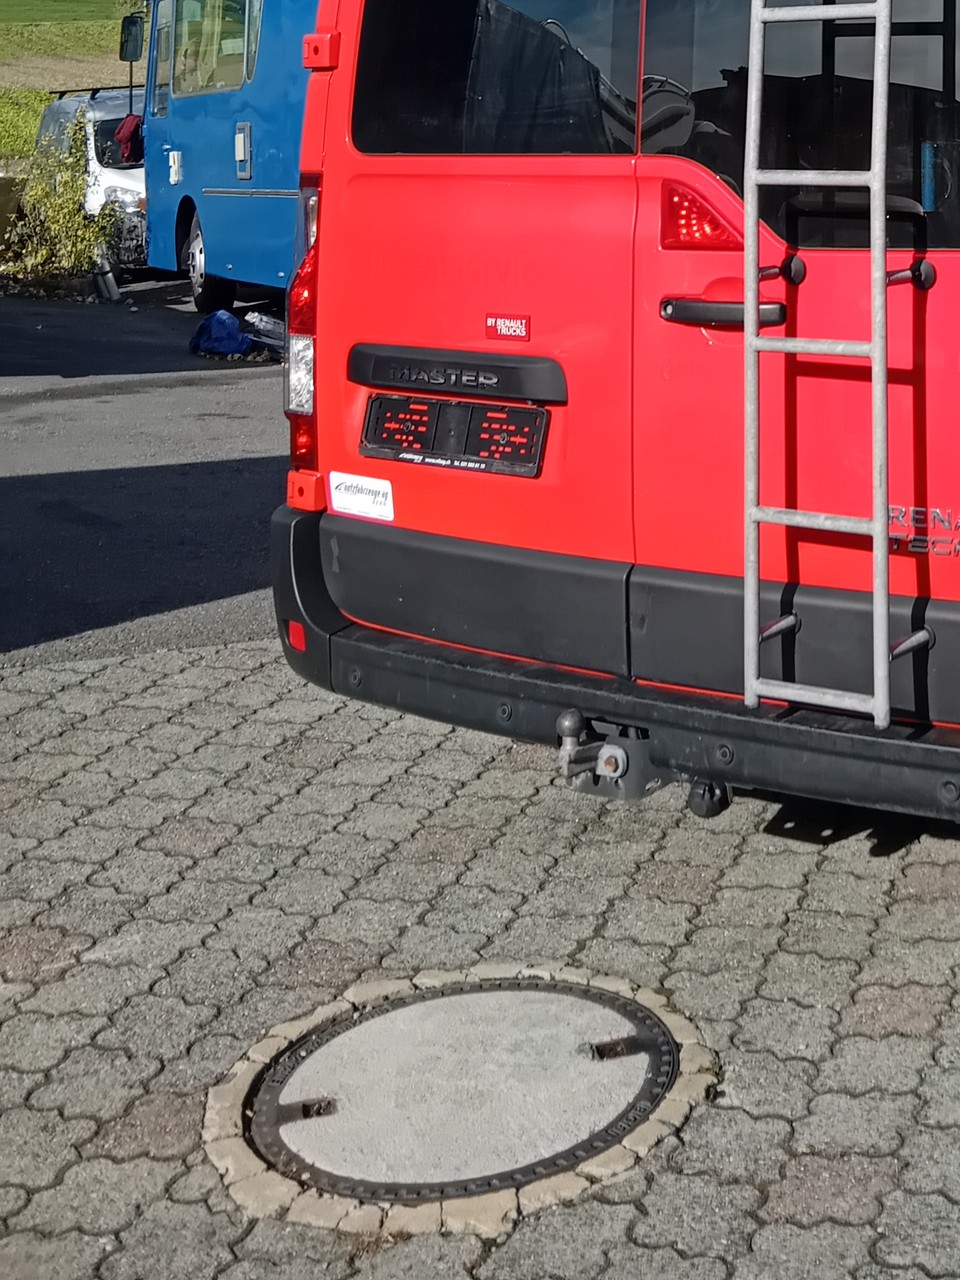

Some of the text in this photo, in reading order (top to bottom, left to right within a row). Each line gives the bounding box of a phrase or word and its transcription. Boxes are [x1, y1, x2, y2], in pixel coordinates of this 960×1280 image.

[487, 317, 527, 328] BY RENAULT
[497, 327, 526, 337] TRUCKS
[389, 364, 499, 389] MASTER
